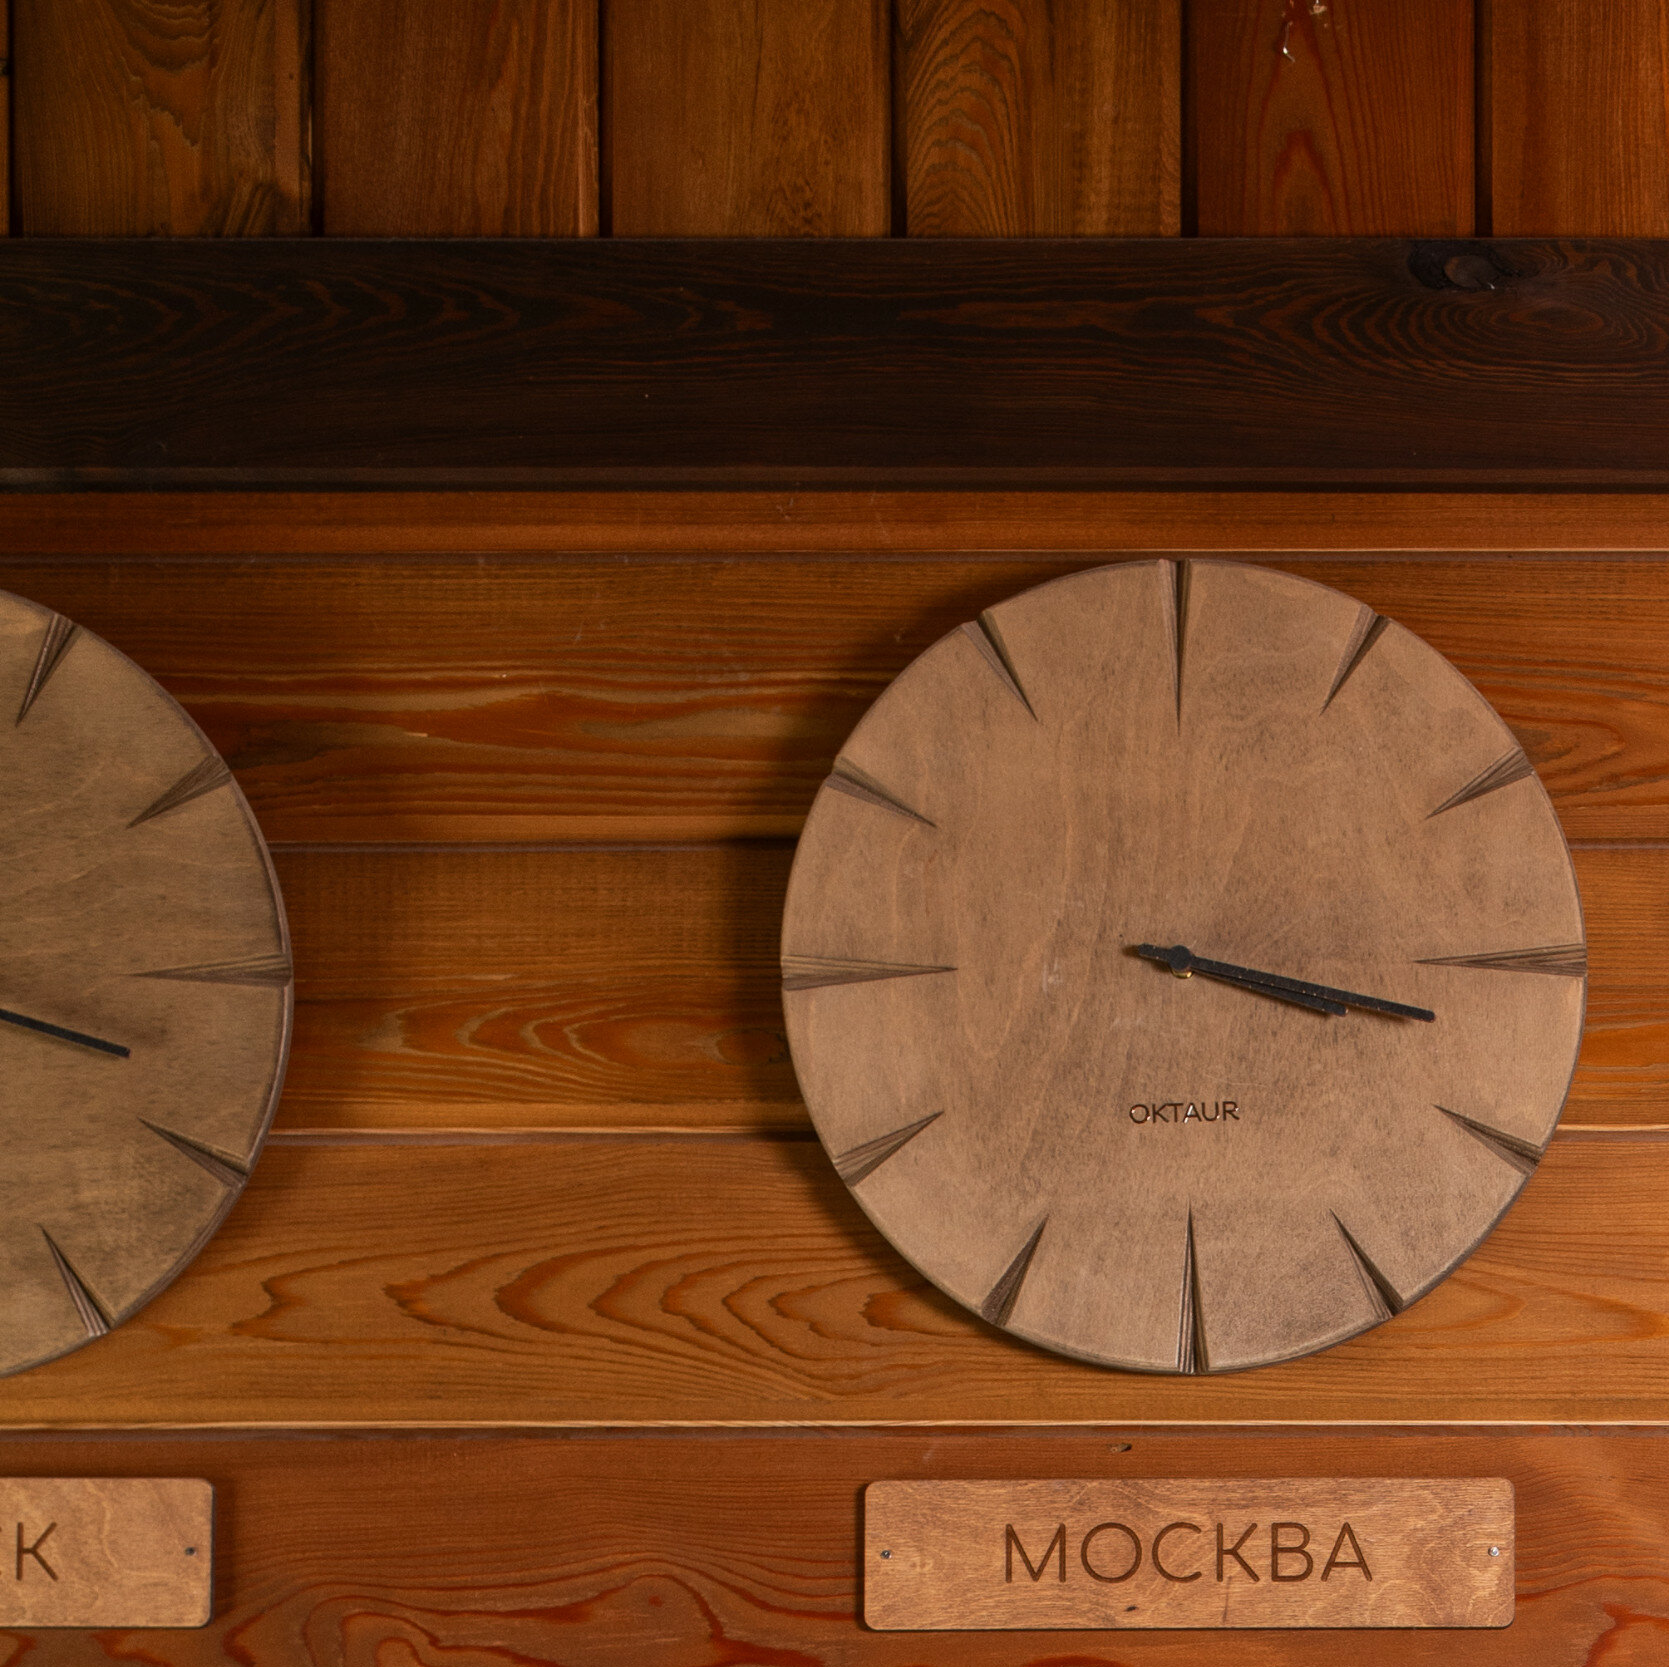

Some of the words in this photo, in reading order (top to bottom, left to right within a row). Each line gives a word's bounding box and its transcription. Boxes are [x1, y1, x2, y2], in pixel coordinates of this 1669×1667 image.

[1129, 1101, 1240, 1124] OKTAUR
[0, 1521, 58, 1581] К
[1005, 1522, 1373, 1584] МОСКВА
